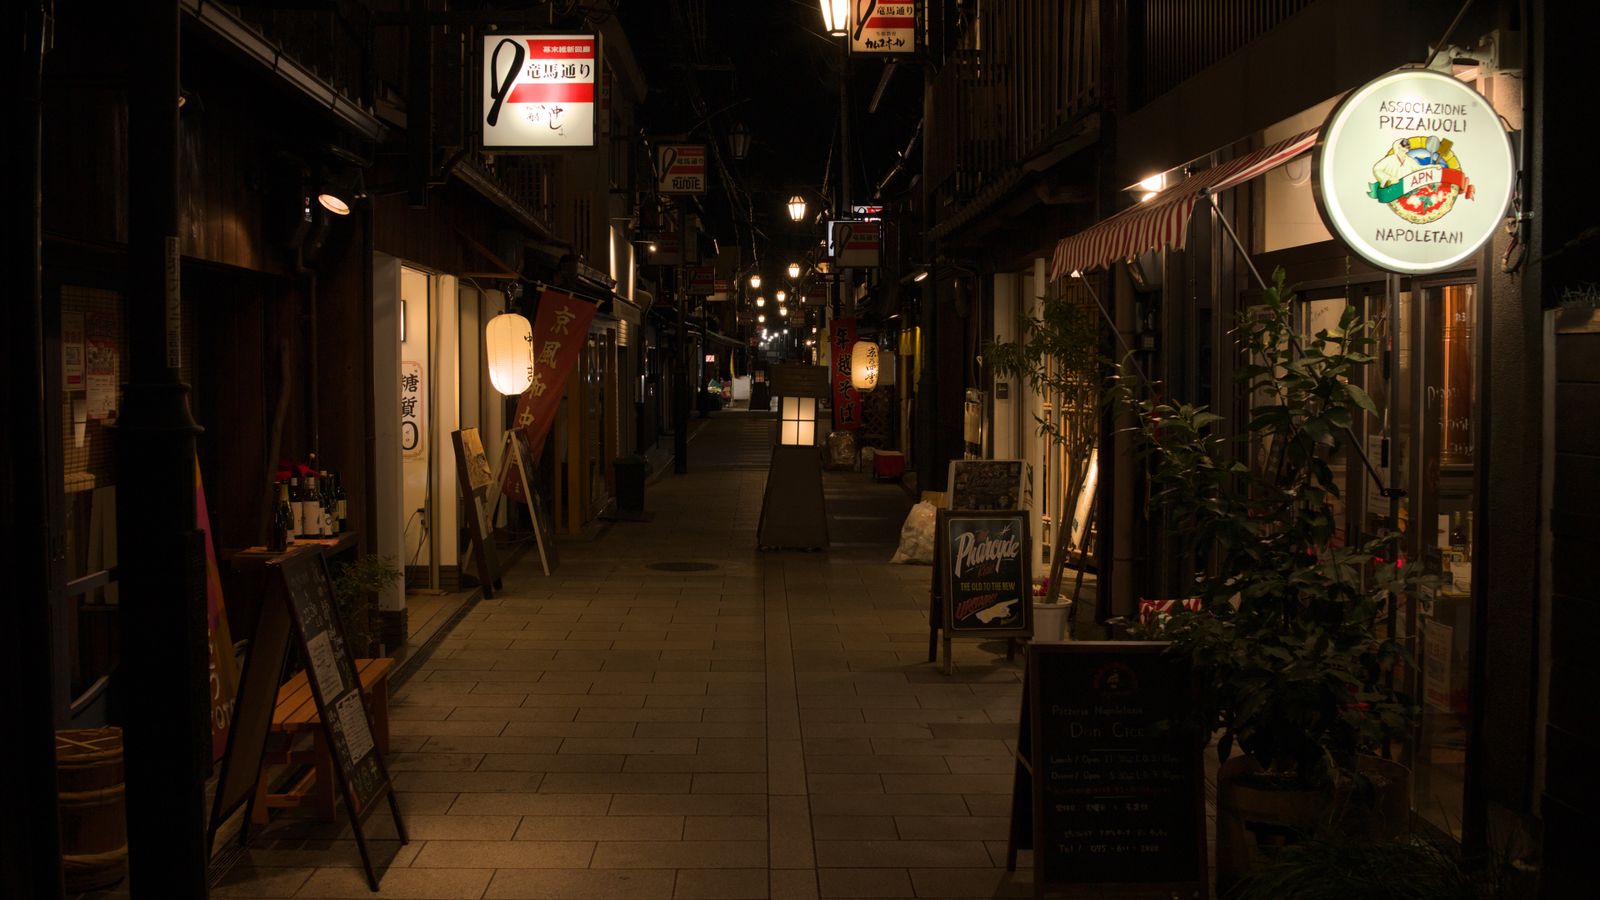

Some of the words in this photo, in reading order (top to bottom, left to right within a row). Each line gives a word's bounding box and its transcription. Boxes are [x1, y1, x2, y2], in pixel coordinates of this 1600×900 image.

[877, 6, 913, 15] 竜馬通り
[527, 63, 591, 79] 竜馬通り
[1379, 101, 1468, 116] ASSOCIAZIONE
[1379, 115, 1467, 133] PIZZAIUOLI
[1410, 170, 1433, 187] APN
[1375, 228, 1463, 244] NAPOLETANI
[960, 581, 971, 591] THE
[971, 581, 983, 591] OLD
[983, 581, 991, 591] TO
[991, 581, 1002, 591] THE
